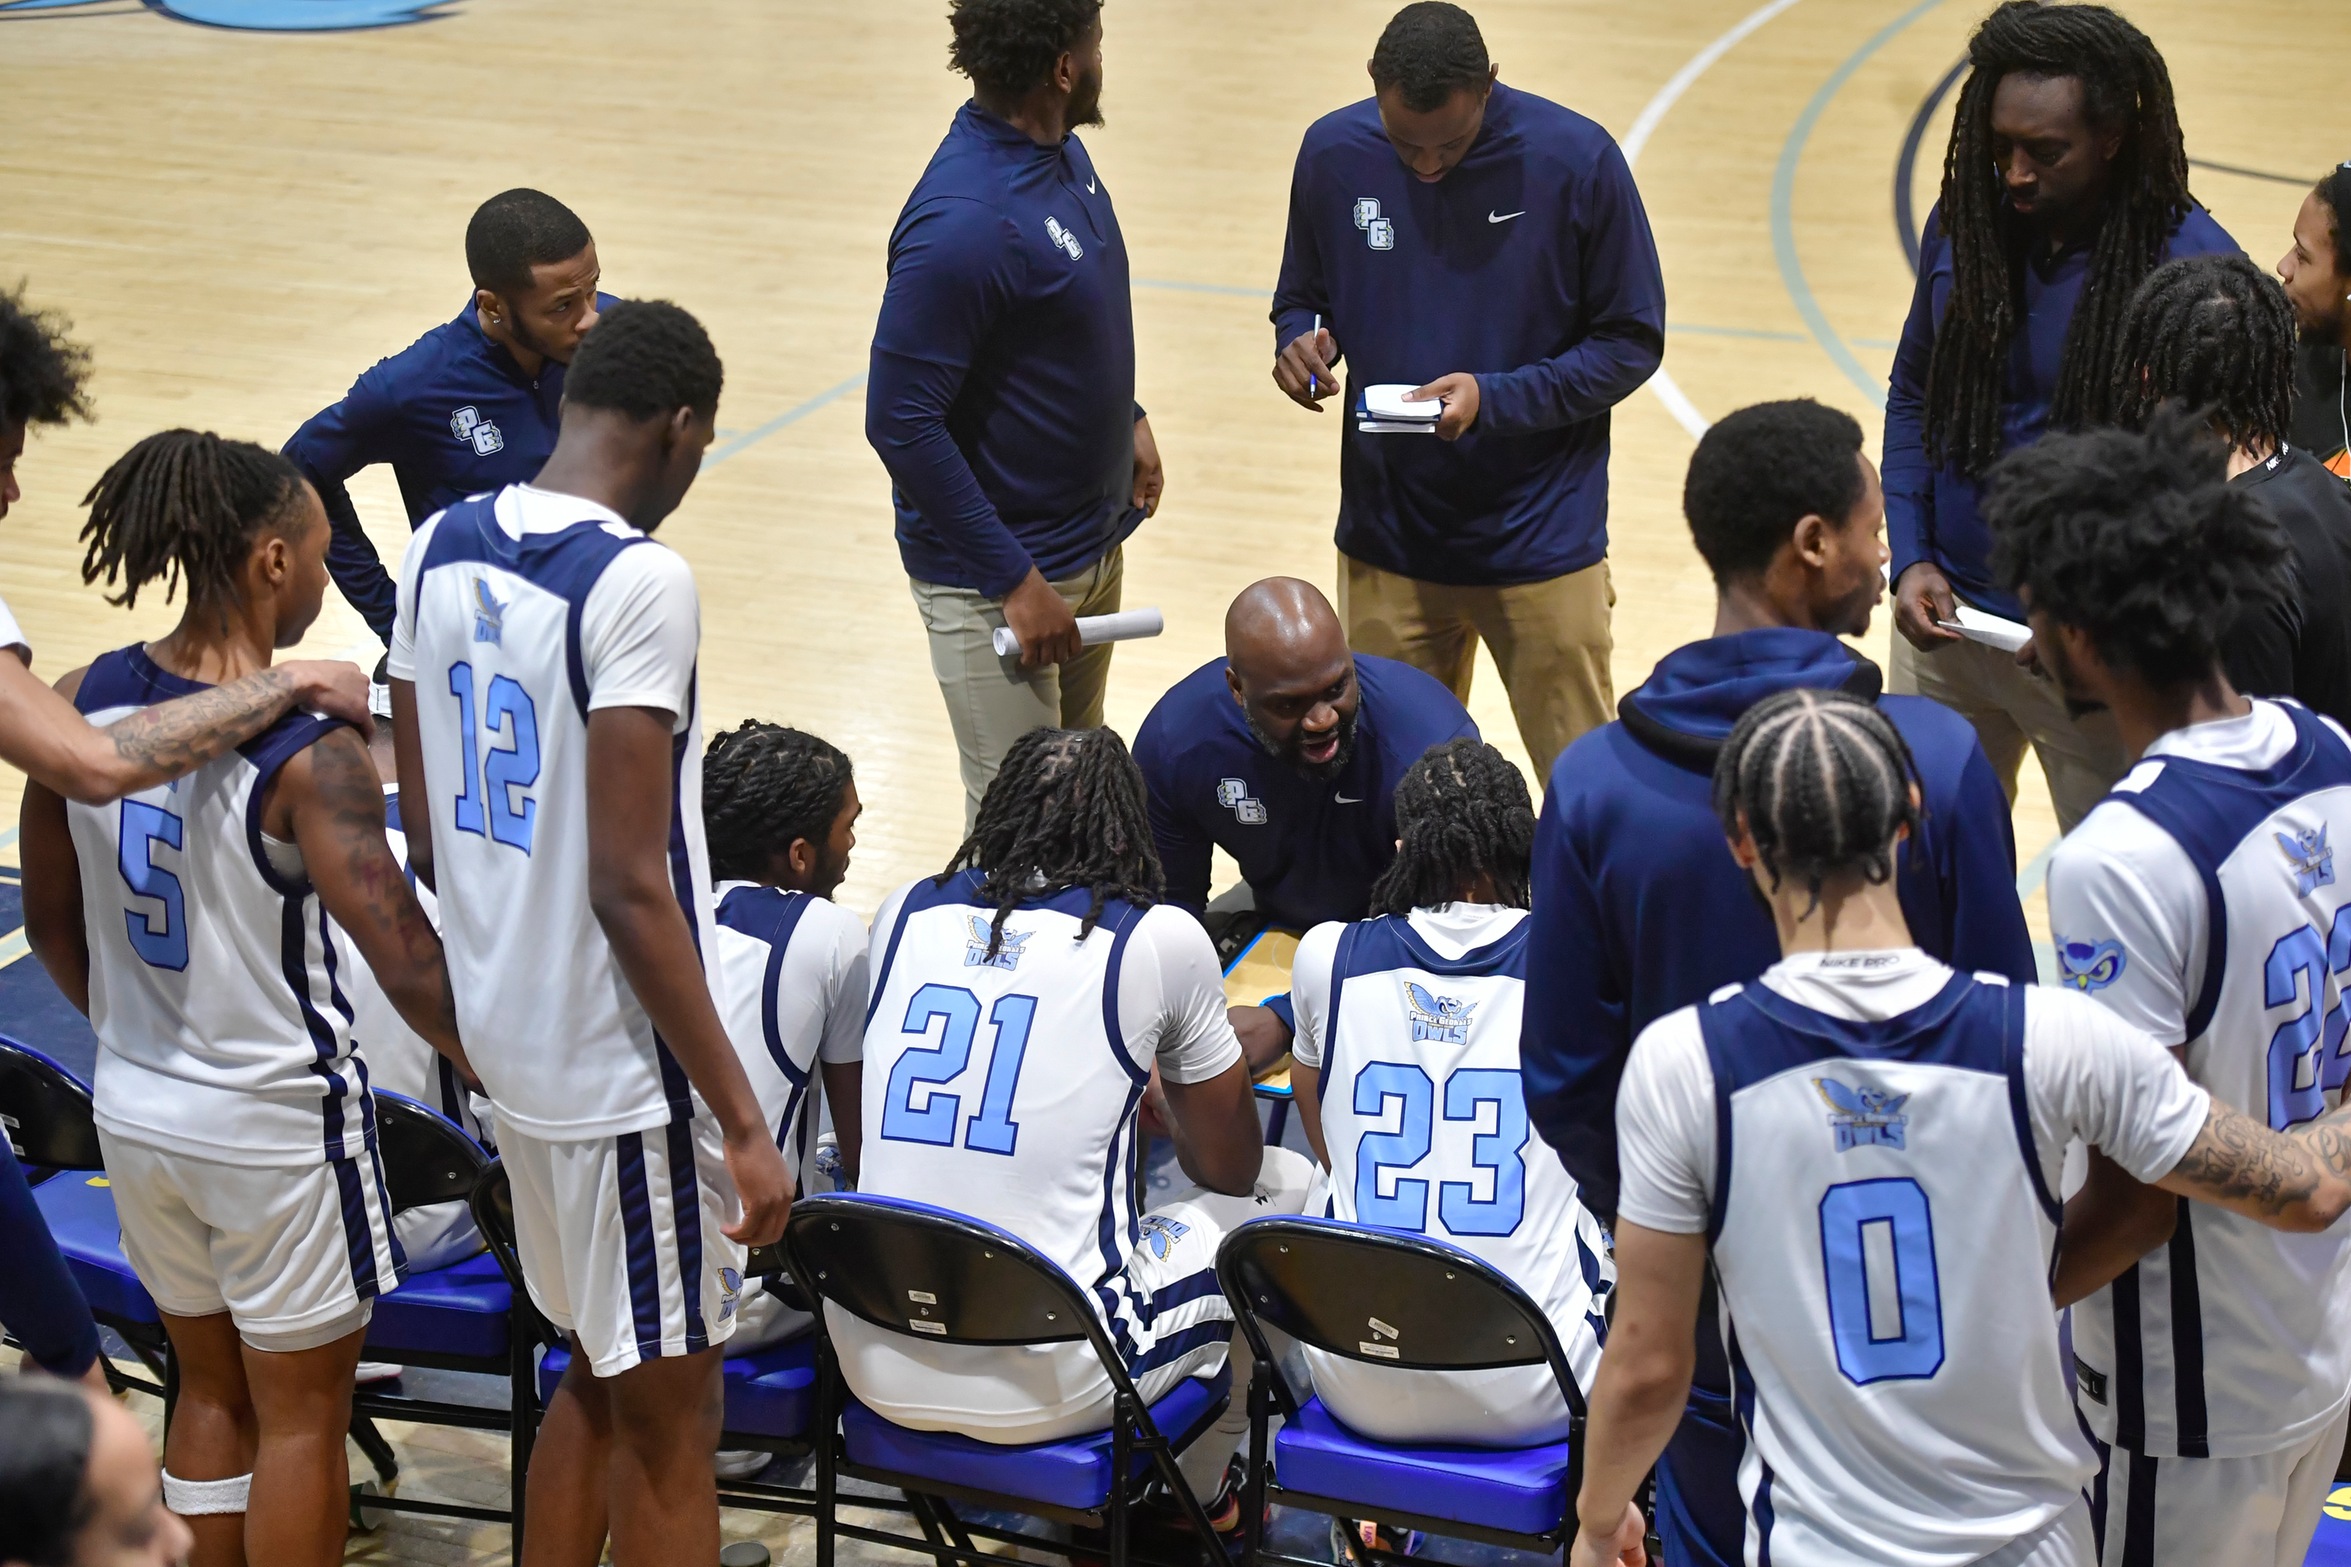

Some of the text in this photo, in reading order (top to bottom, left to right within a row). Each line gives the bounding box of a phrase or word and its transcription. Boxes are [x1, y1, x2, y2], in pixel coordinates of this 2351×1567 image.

[1044, 216, 1084, 261] PG
[1354, 197, 1394, 251] PG
[450, 405, 504, 457] PG
[448, 660, 540, 858] 12
[1217, 777, 1267, 825] PG
[118, 797, 189, 973] 5
[1820, 956, 1900, 969] NIKE PRO
[1412, 1020, 1468, 1045] OWLS
[881, 983, 1039, 1157] 21
[1353, 1060, 1530, 1237] 23
[1834, 1122, 1906, 1153] OWLS
[1819, 1177, 1945, 1387] 0
